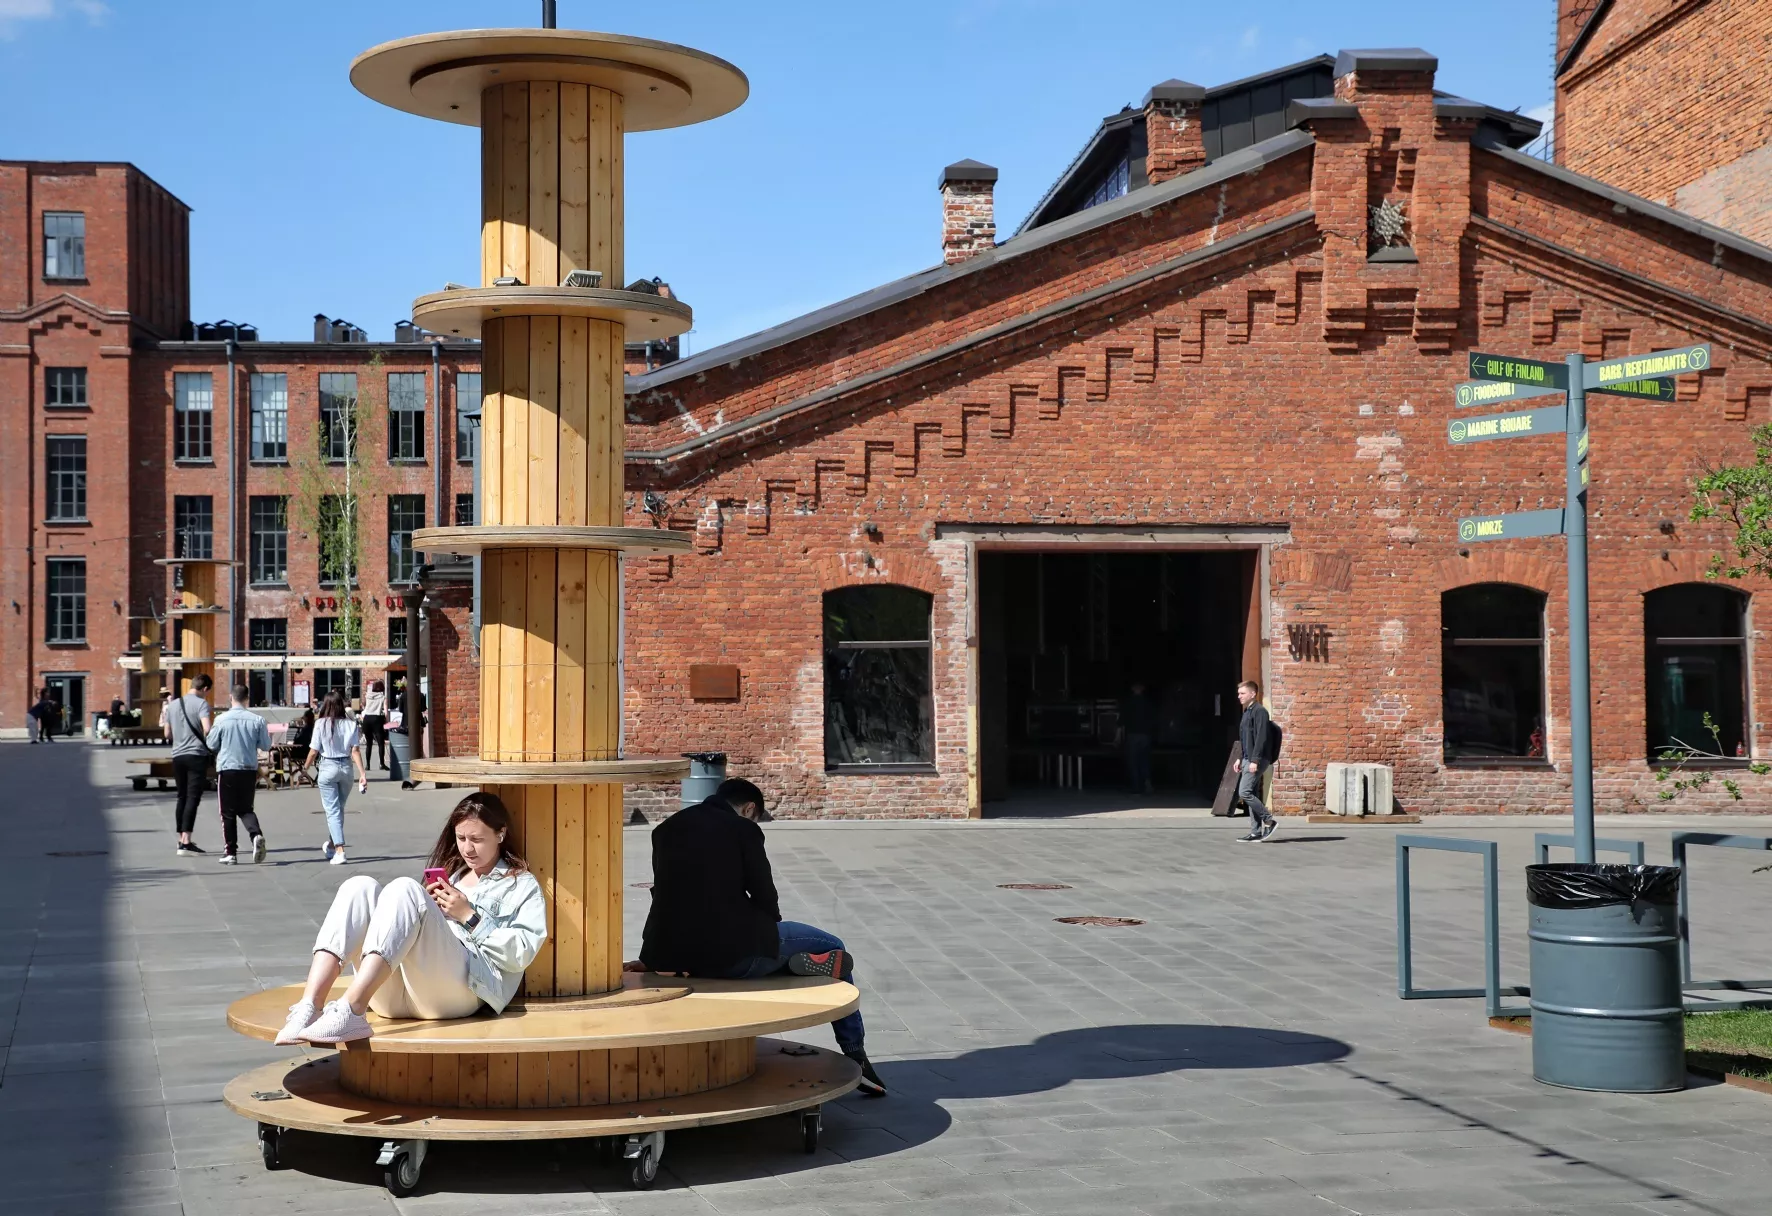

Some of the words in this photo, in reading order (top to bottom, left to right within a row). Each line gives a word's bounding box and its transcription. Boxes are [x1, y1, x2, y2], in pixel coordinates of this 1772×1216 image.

[1487, 360, 1504, 376] GULF
[1505, 362, 1514, 378] OF
[1515, 364, 1544, 381] FINLAND
[1467, 419, 1499, 437] MARINE
[1500, 415, 1532, 433] SQUARE
[1477, 519, 1503, 536] MORZE
